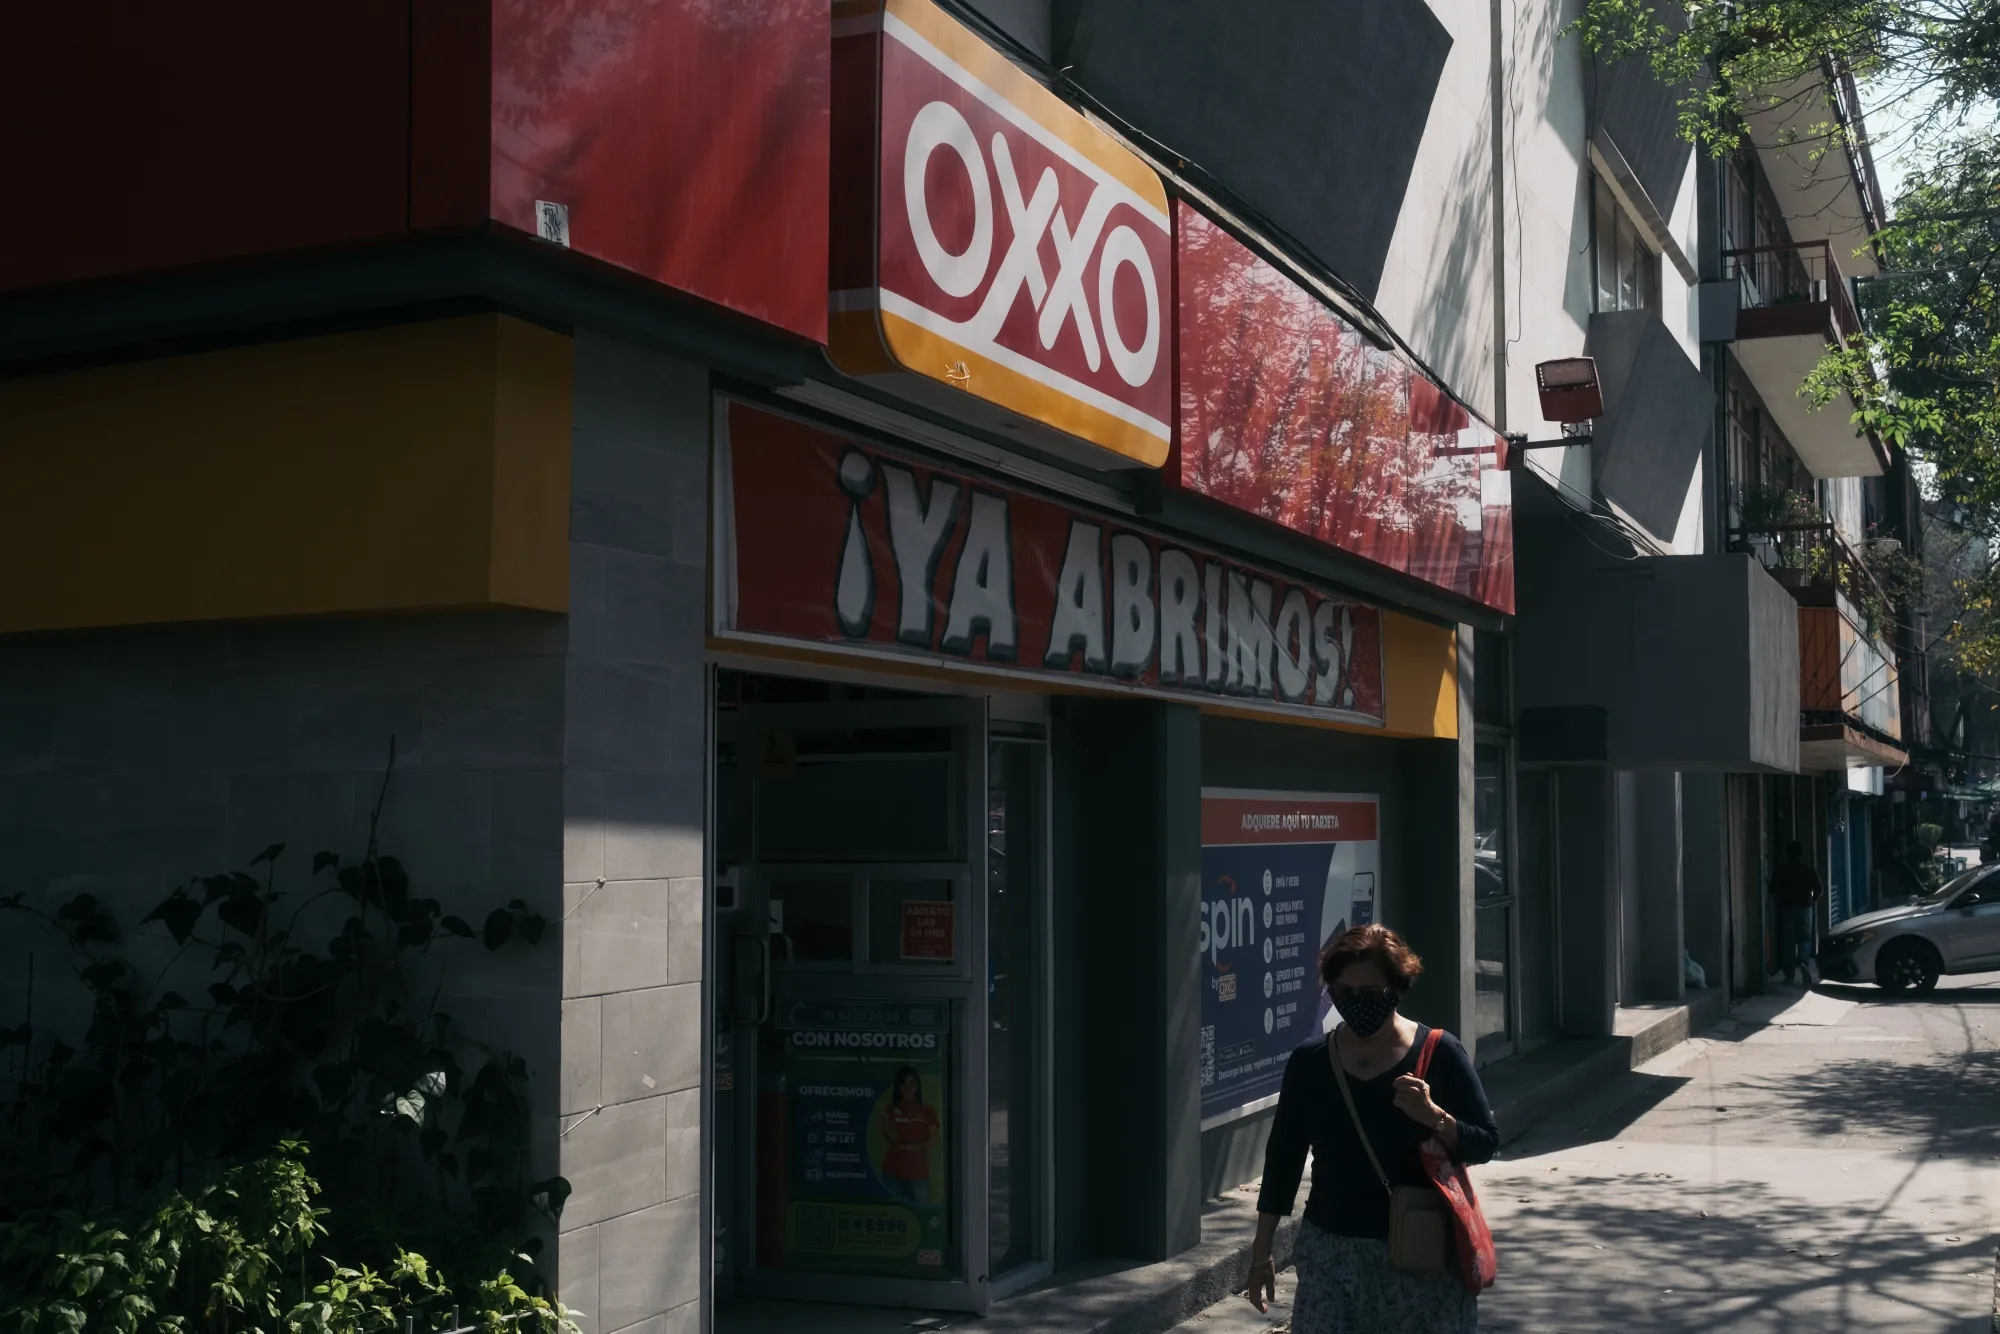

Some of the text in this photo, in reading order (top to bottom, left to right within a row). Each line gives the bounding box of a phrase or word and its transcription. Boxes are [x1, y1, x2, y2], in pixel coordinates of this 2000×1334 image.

[903, 100, 1161, 388] OXXO
[834, 443, 1359, 711] ¡YA ABRIMOS!
[1241, 811, 1340, 832] ADQUIERE AQUÍ TU TARJETA
[905, 905, 951, 917] ABIERTO
[916, 917, 936, 927] LAS
[908, 928, 922, 938] 24
[1200, 897, 1255, 967] spin
[1211, 976, 1219, 991] by
[792, 1031, 936, 1049] CON NOSOTROS
[1218, 1067, 1239, 1081] Descarga
[799, 1085, 875, 1098] OFRECEMOS:
[825, 1111, 850, 1119] PAGO
[825, 1135, 856, 1144] DE LEY
[918, 1252, 941, 1262] OXXO
